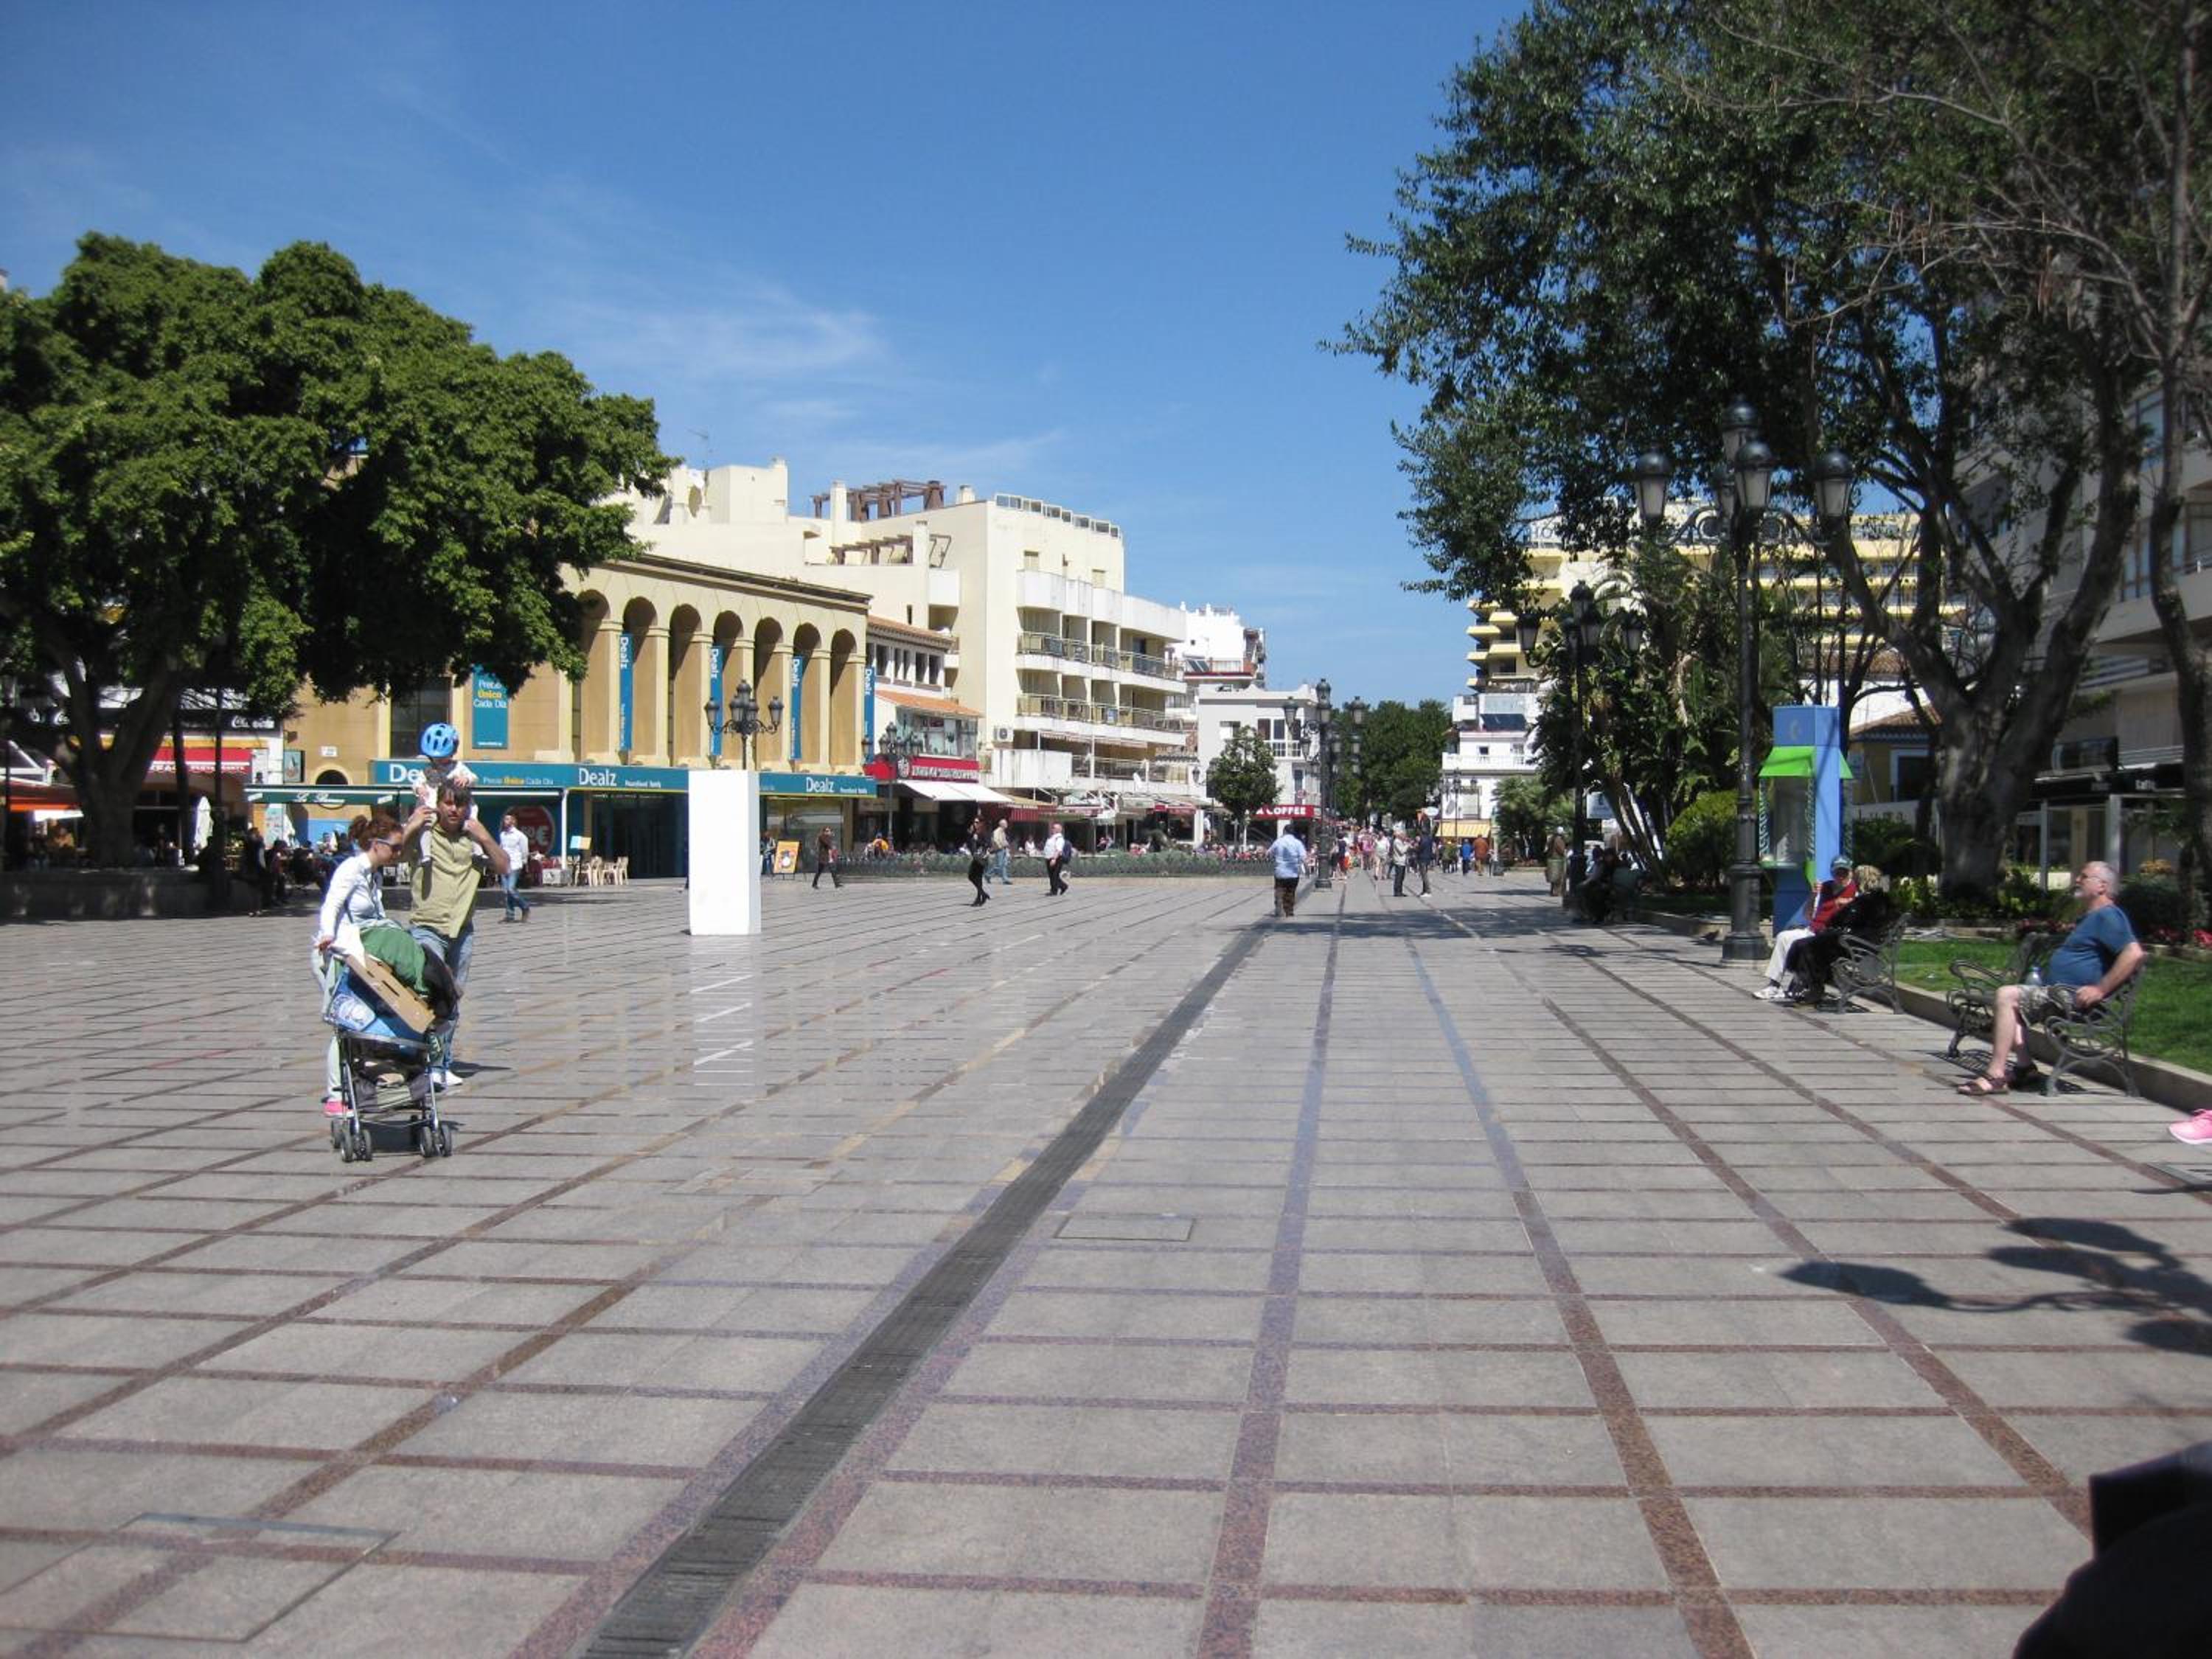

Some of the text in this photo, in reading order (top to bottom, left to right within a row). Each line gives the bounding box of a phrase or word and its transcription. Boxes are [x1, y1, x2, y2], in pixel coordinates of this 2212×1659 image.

[620, 636, 629, 669] Dealz
[711, 648, 719, 679] Dealz
[792, 658, 800, 687] Dealz
[578, 768, 617, 787] Dealz
[806, 776, 835, 793] Dealz
